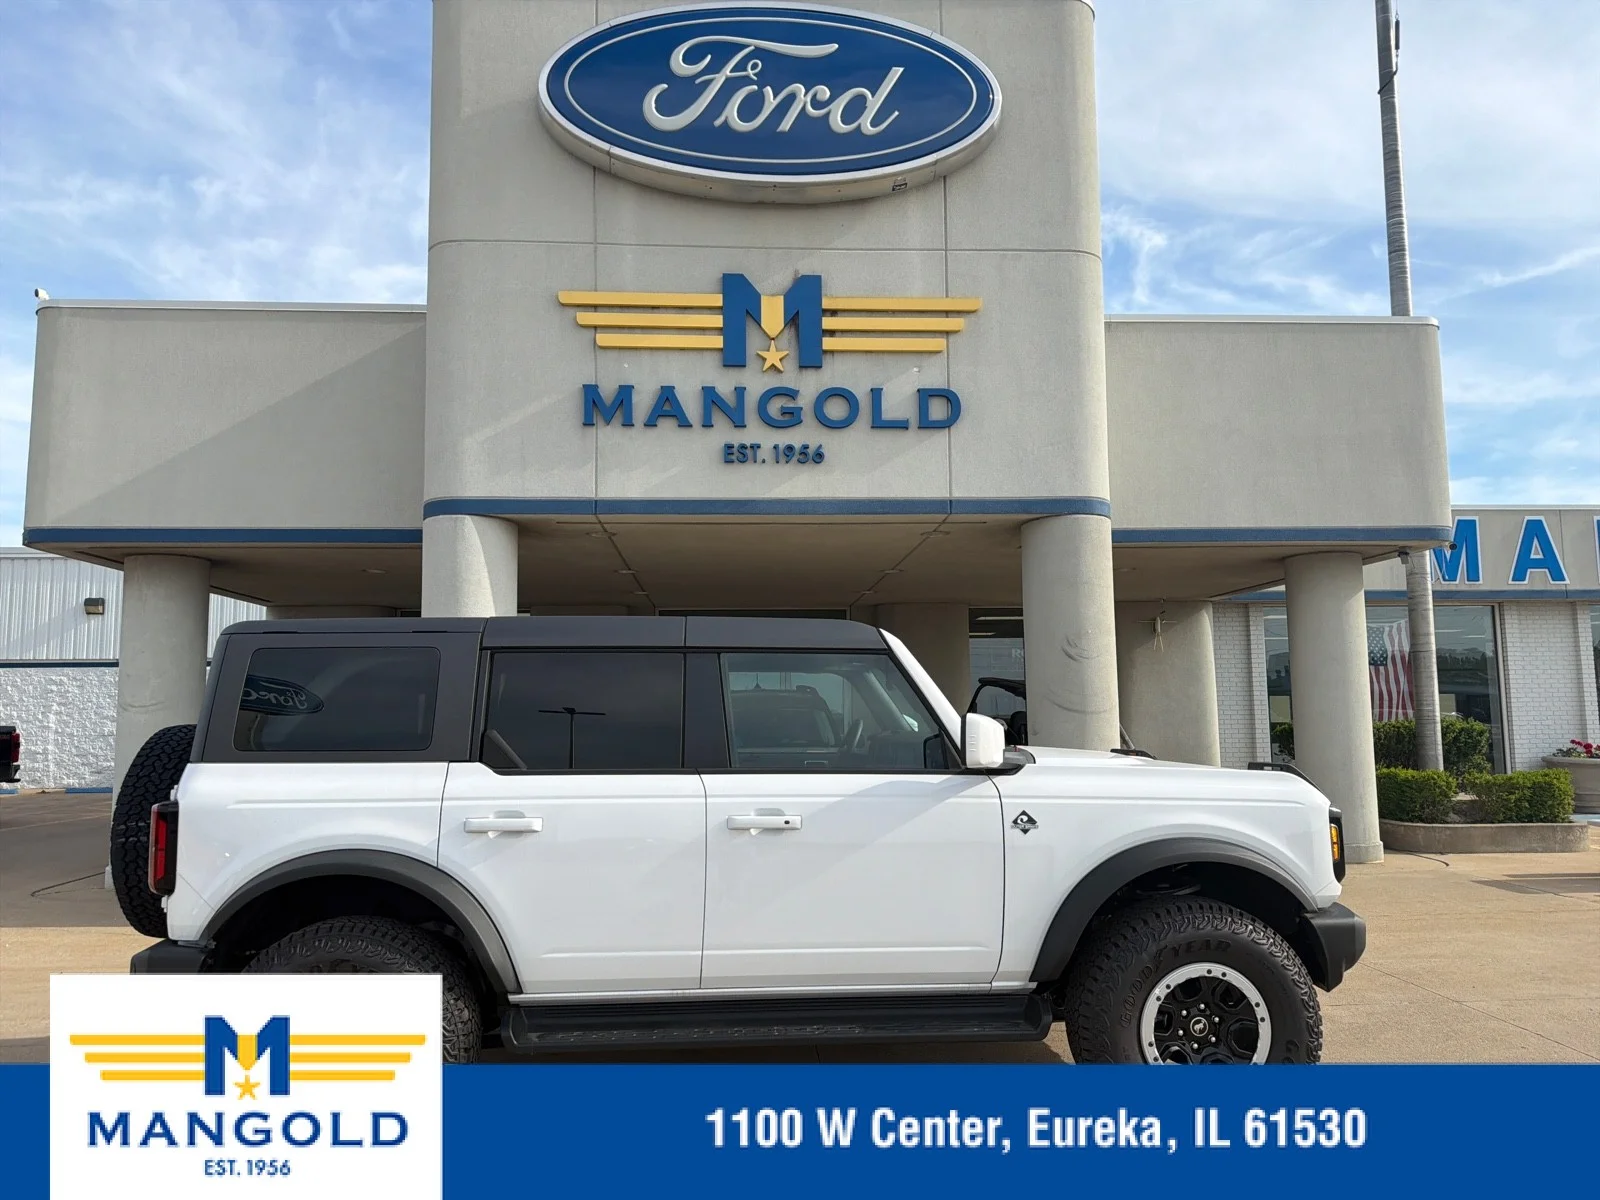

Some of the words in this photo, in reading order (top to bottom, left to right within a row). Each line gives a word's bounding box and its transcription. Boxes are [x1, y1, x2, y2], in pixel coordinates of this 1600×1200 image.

[642, 35, 906, 136] Ford
[721, 272, 823, 368] M
[582, 383, 962, 430] MANGOLD
[723, 442, 767, 465] EST.
[772, 443, 825, 466] 1956
[1431, 515, 1600, 585] MA
